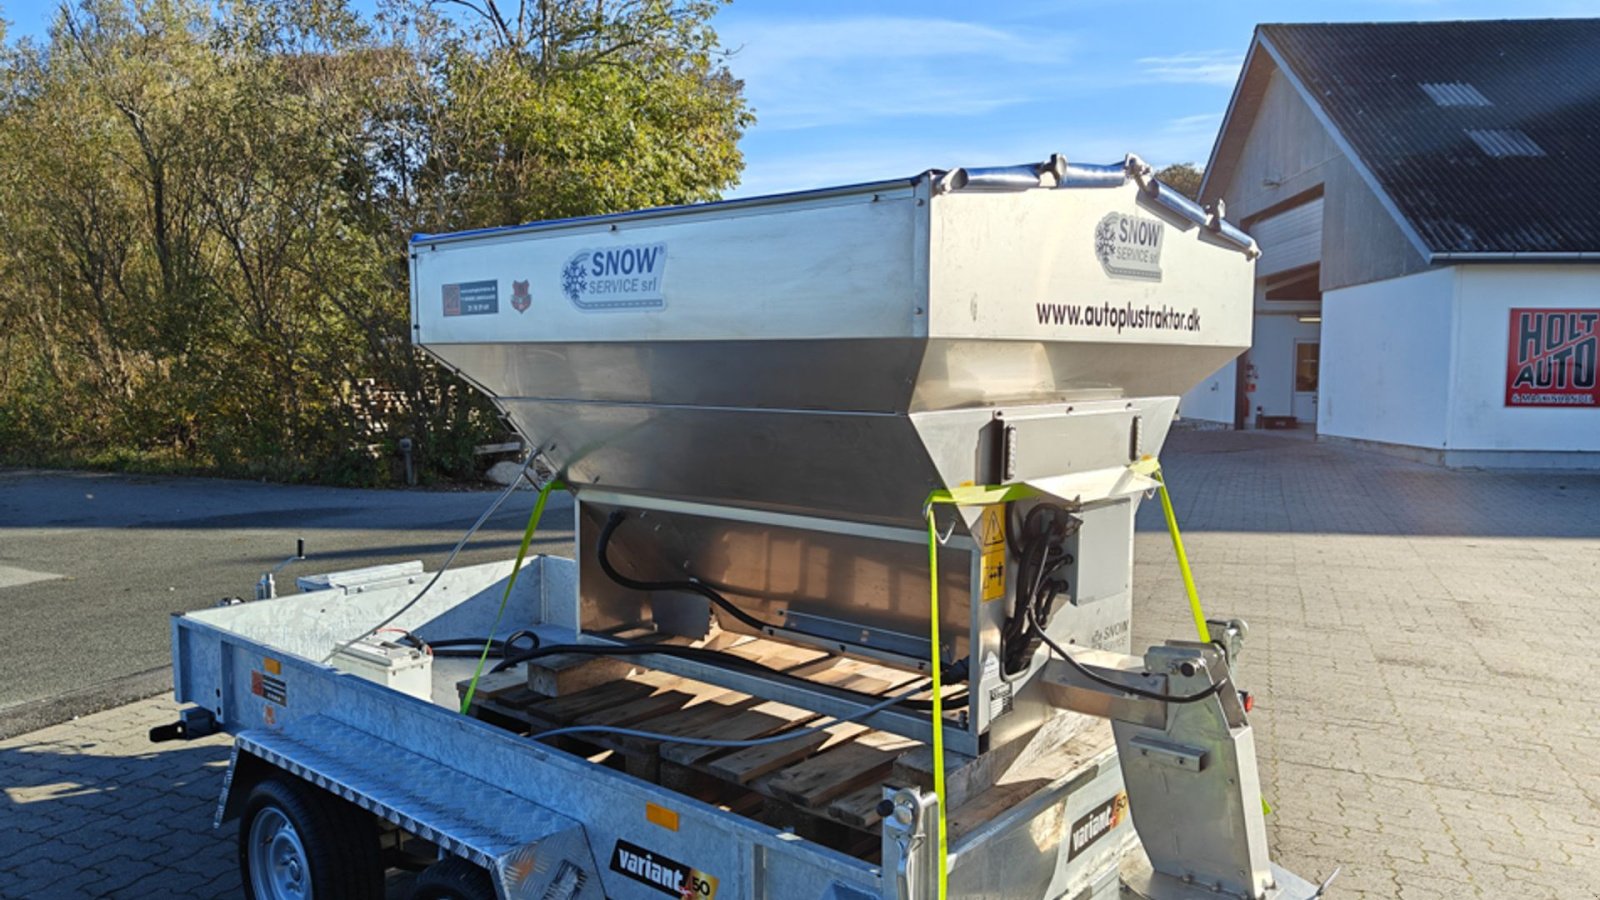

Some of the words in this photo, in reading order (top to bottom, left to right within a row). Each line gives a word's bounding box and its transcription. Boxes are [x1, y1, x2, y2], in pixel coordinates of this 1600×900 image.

[1119, 218, 1160, 247] SNOW
[591, 246, 658, 276] SNOW
[589, 279, 638, 294] SERVICE
[641, 277, 657, 292] srl
[1036, 301, 1200, 334] www.autoplustraktor.dk
[1518, 312, 1600, 365] HOLT
[1512, 336, 1598, 389] AUTO
[1073, 805, 1112, 852] variant
[618, 848, 684, 893] variant
[692, 876, 710, 896] 50
